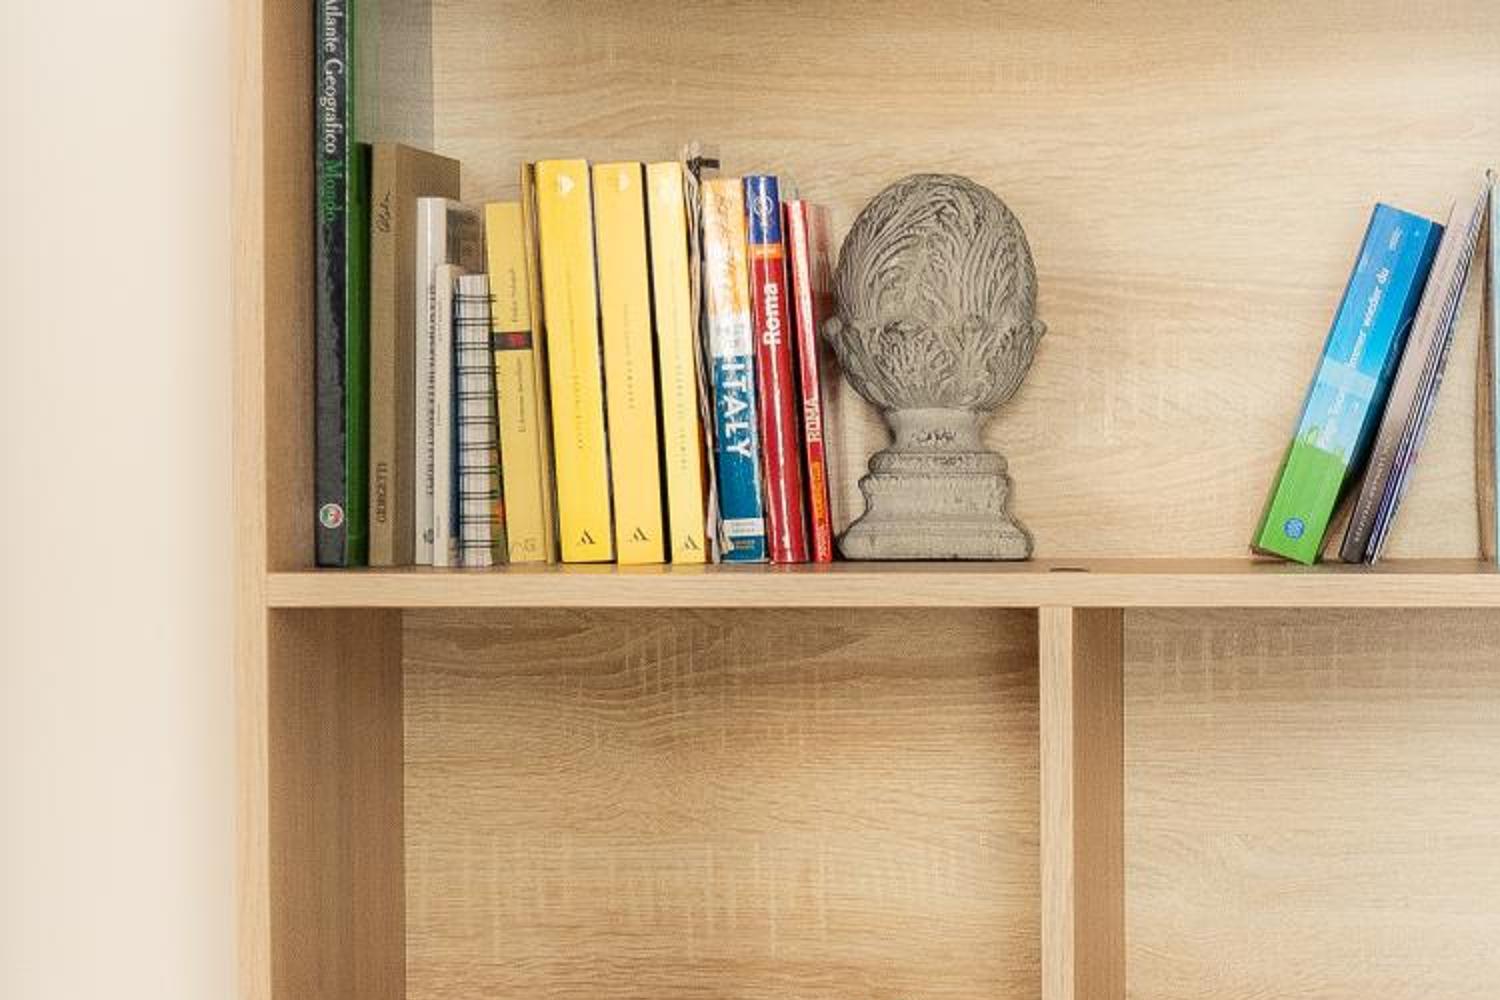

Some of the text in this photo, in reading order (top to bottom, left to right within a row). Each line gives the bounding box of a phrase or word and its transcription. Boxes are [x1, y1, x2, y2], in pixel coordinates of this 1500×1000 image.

[320, 58, 344, 155] Geografico
[324, 159, 344, 222] Mondo
[762, 282, 784, 346] Roma
[721, 362, 753, 458] ITALY
[804, 395, 822, 444] ROMA
